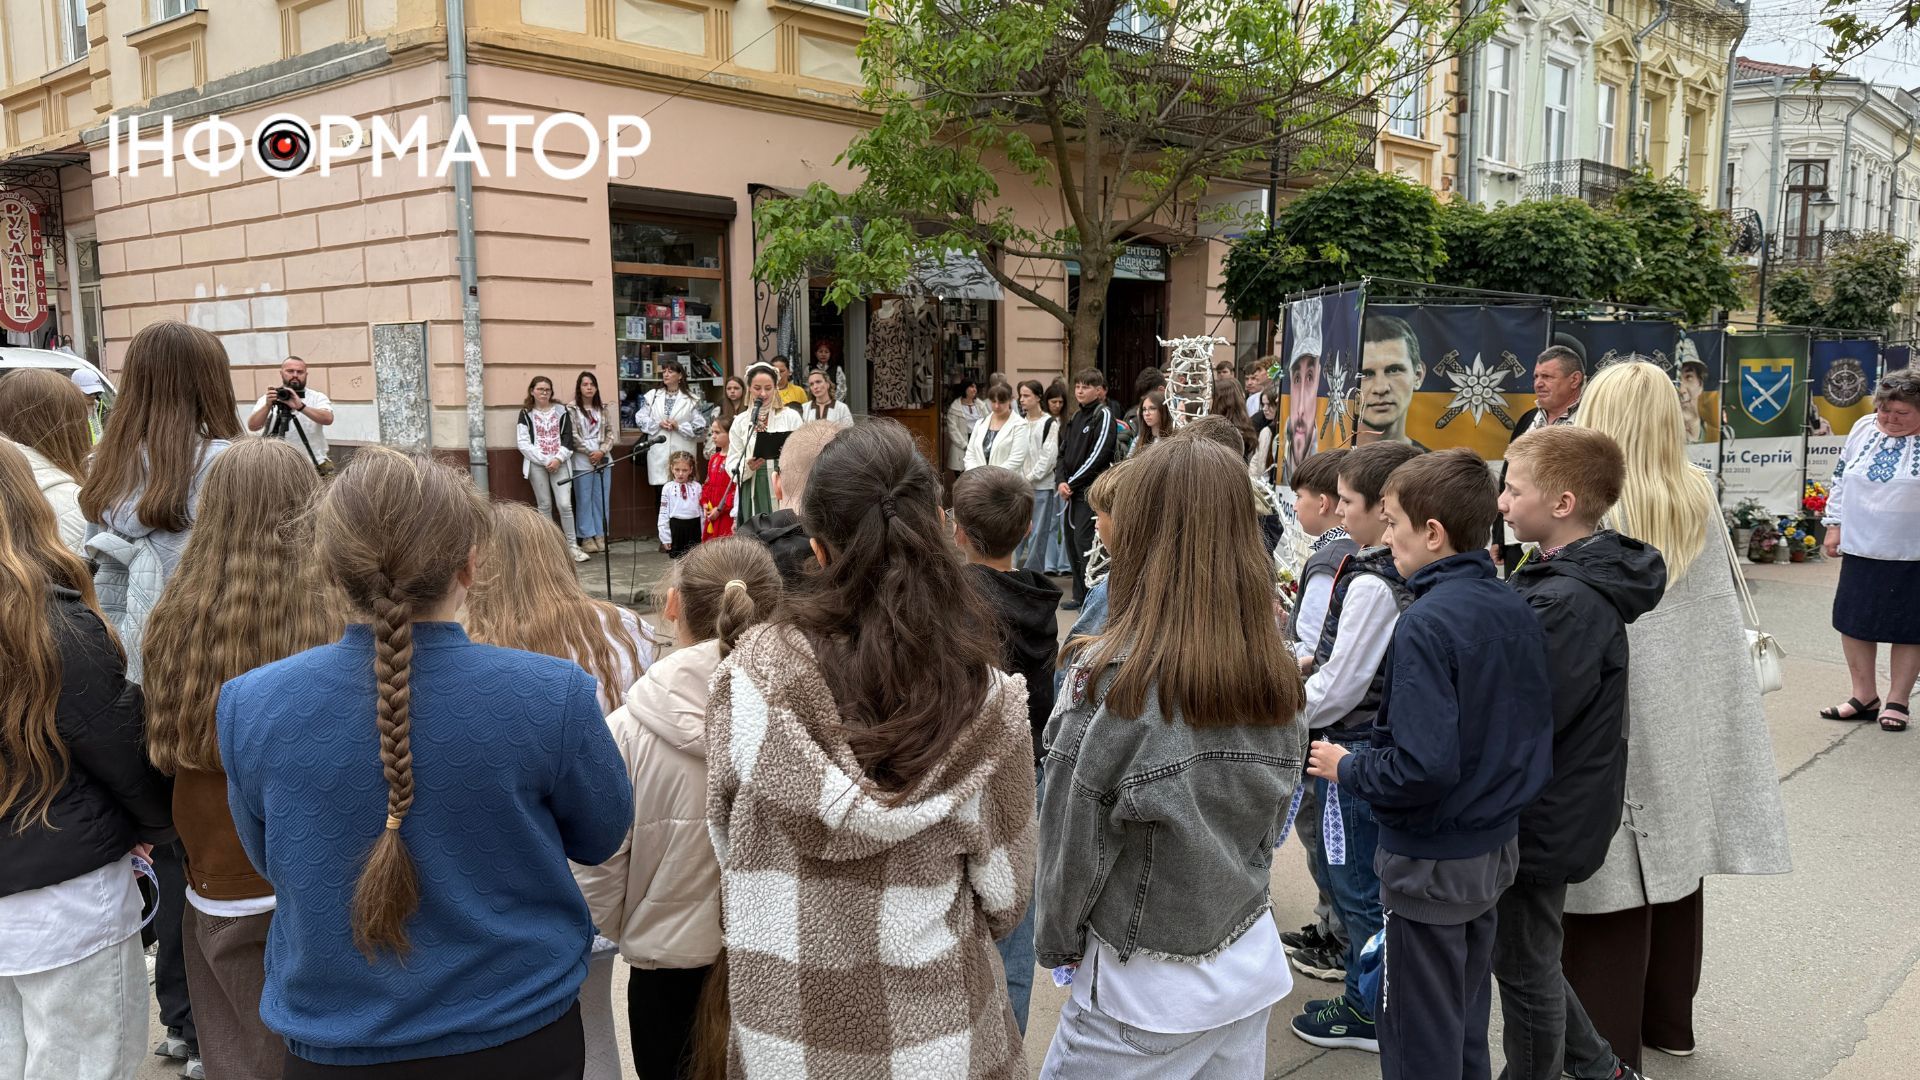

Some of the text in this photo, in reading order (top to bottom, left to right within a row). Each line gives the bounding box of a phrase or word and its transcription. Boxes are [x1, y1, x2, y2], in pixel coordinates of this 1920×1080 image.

[6, 202, 33, 318] РУСЛАНЧИК
[1125, 245, 1161, 257] ЕНТСТВО
[1741, 449, 1793, 467] Сергій
